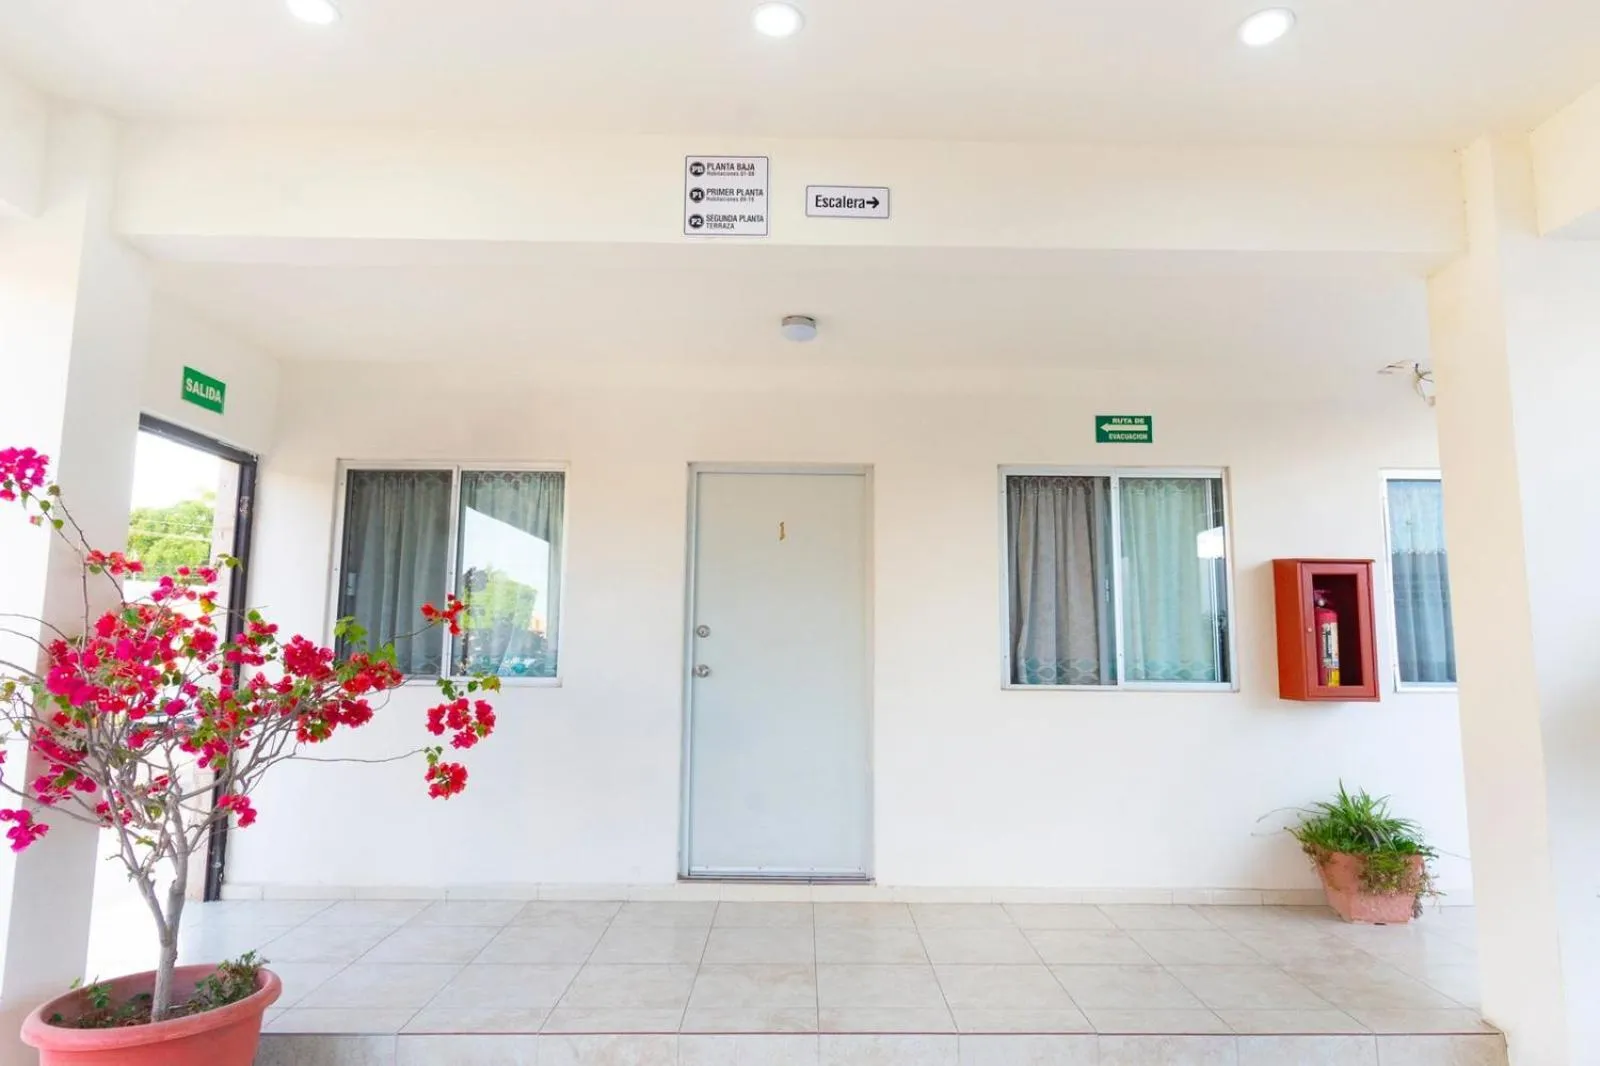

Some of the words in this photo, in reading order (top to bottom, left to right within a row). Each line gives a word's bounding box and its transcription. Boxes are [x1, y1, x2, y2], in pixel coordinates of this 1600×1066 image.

[736, 163, 755, 171] BAJA
[736, 188, 764, 196] PLANTA
[815, 194, 866, 208] Escalera
[186, 378, 222, 404] SALIDA
